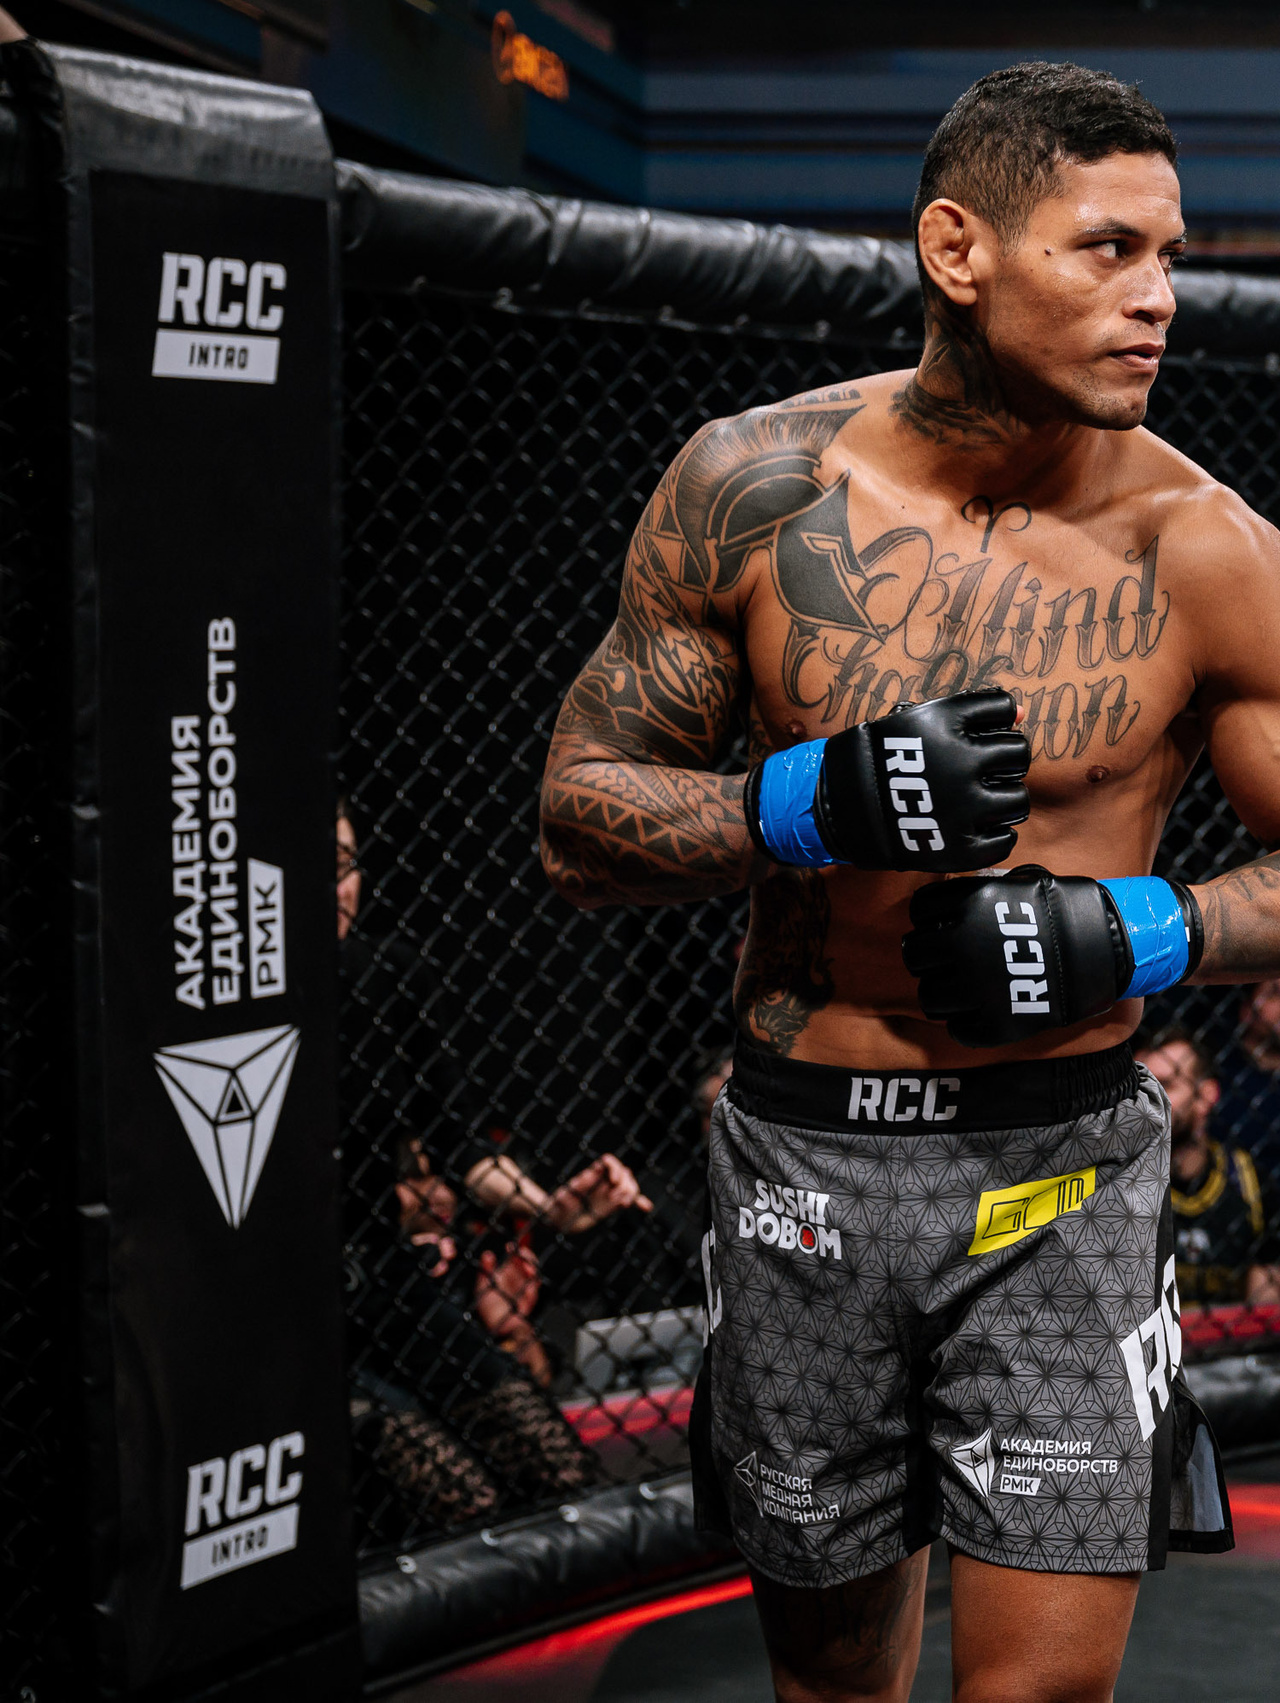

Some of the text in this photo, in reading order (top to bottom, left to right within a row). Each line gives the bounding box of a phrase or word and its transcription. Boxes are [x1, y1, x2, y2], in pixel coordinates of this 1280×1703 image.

[158, 251, 287, 331] RCC
[188, 343, 249, 370] INTRO
[208, 616, 244, 1005] ЕДИНОБОРСТВ
[883, 736, 946, 853] RCC
[172, 715, 207, 1010] АКАДЕМИЯ
[254, 881, 278, 988] РМК
[995, 901, 1050, 1015] RCC
[847, 1076, 961, 1123] RCC
[754, 1178, 830, 1225] SUSHI
[738, 1207, 842, 1260] DOBOM
[1000, 1439, 1092, 1455] АКАДЕМИЯ
[1003, 1455, 1119, 1473] ЕДИНОБОРСТВ
[184, 1430, 305, 1536] RCC
[760, 1464, 813, 1491] РУССКАЯ
[762, 1482, 813, 1508] МЕДНАЯ
[1002, 1477, 1034, 1493] РМК
[763, 1499, 841, 1524] КОМПАНИЯ
[212, 1523, 268, 1566] INTRO
